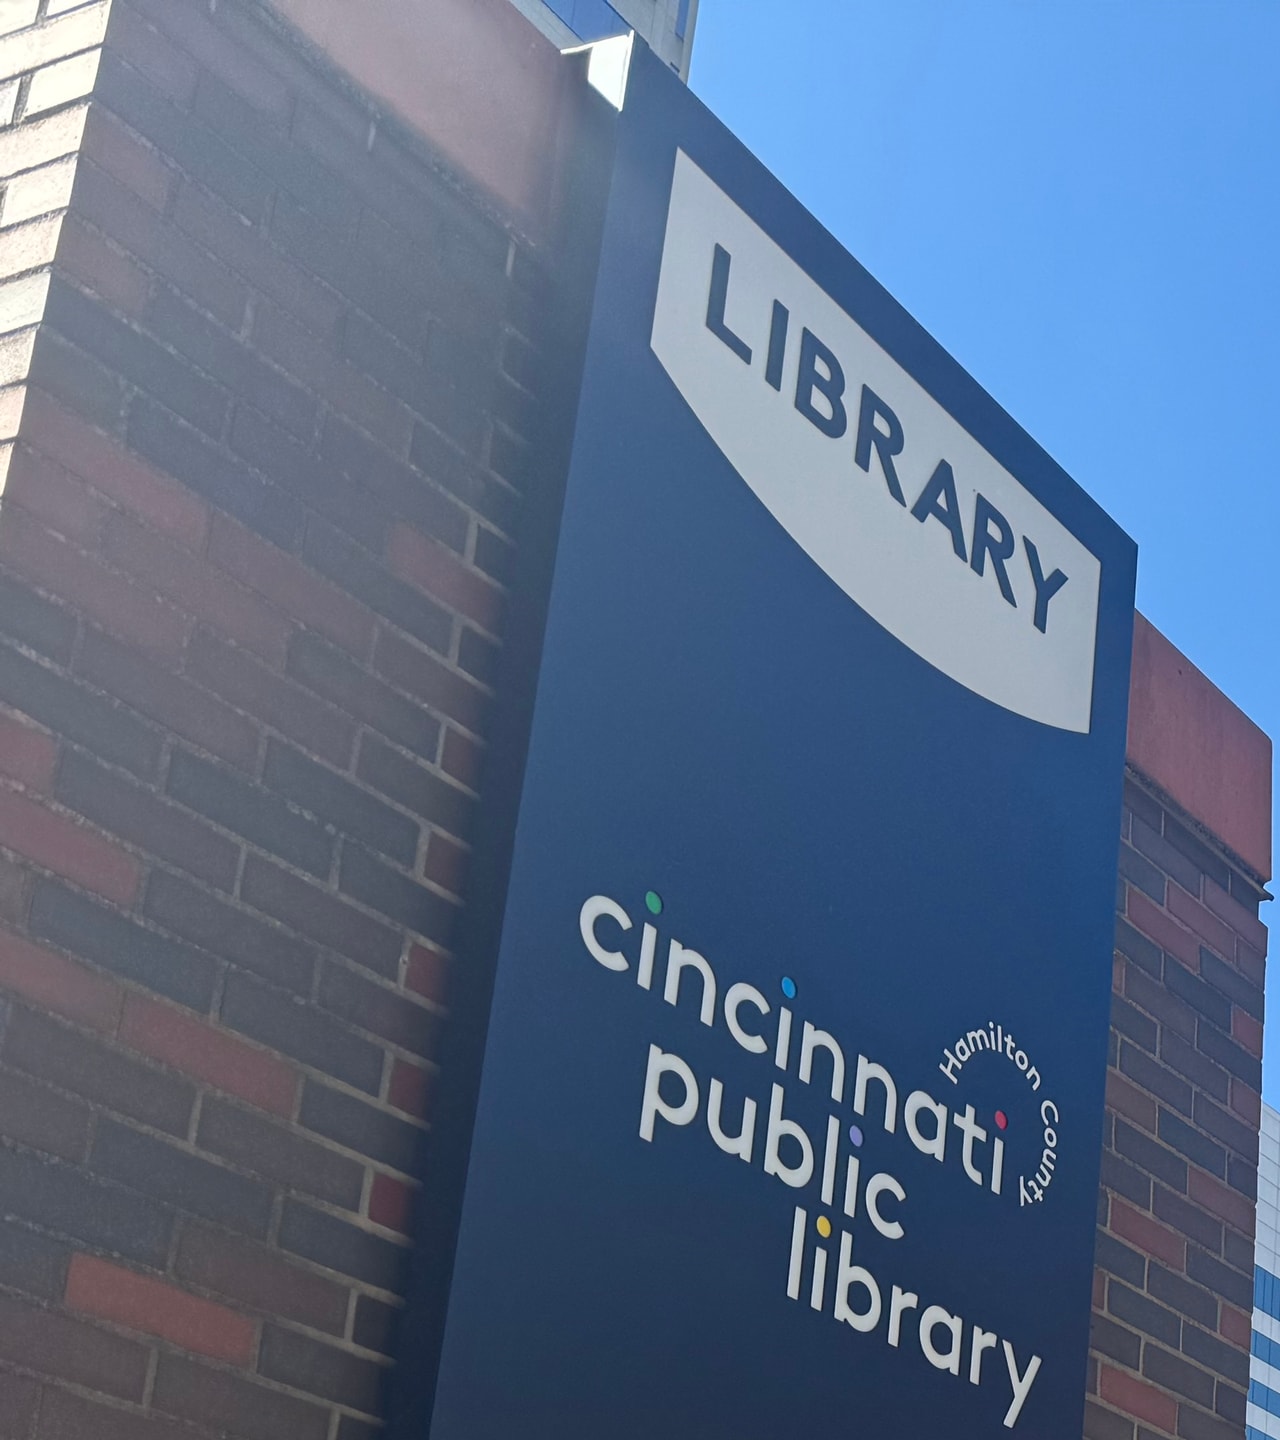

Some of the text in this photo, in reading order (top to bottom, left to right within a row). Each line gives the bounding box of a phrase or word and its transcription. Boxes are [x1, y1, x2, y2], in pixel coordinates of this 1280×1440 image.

[705, 242, 1069, 635] LIBRARY
[579, 891, 1008, 1195] cincinnati
[639, 1044, 906, 1240] public
[939, 1021, 1059, 1207] Hamilton County
[787, 1206, 1042, 1429] library
